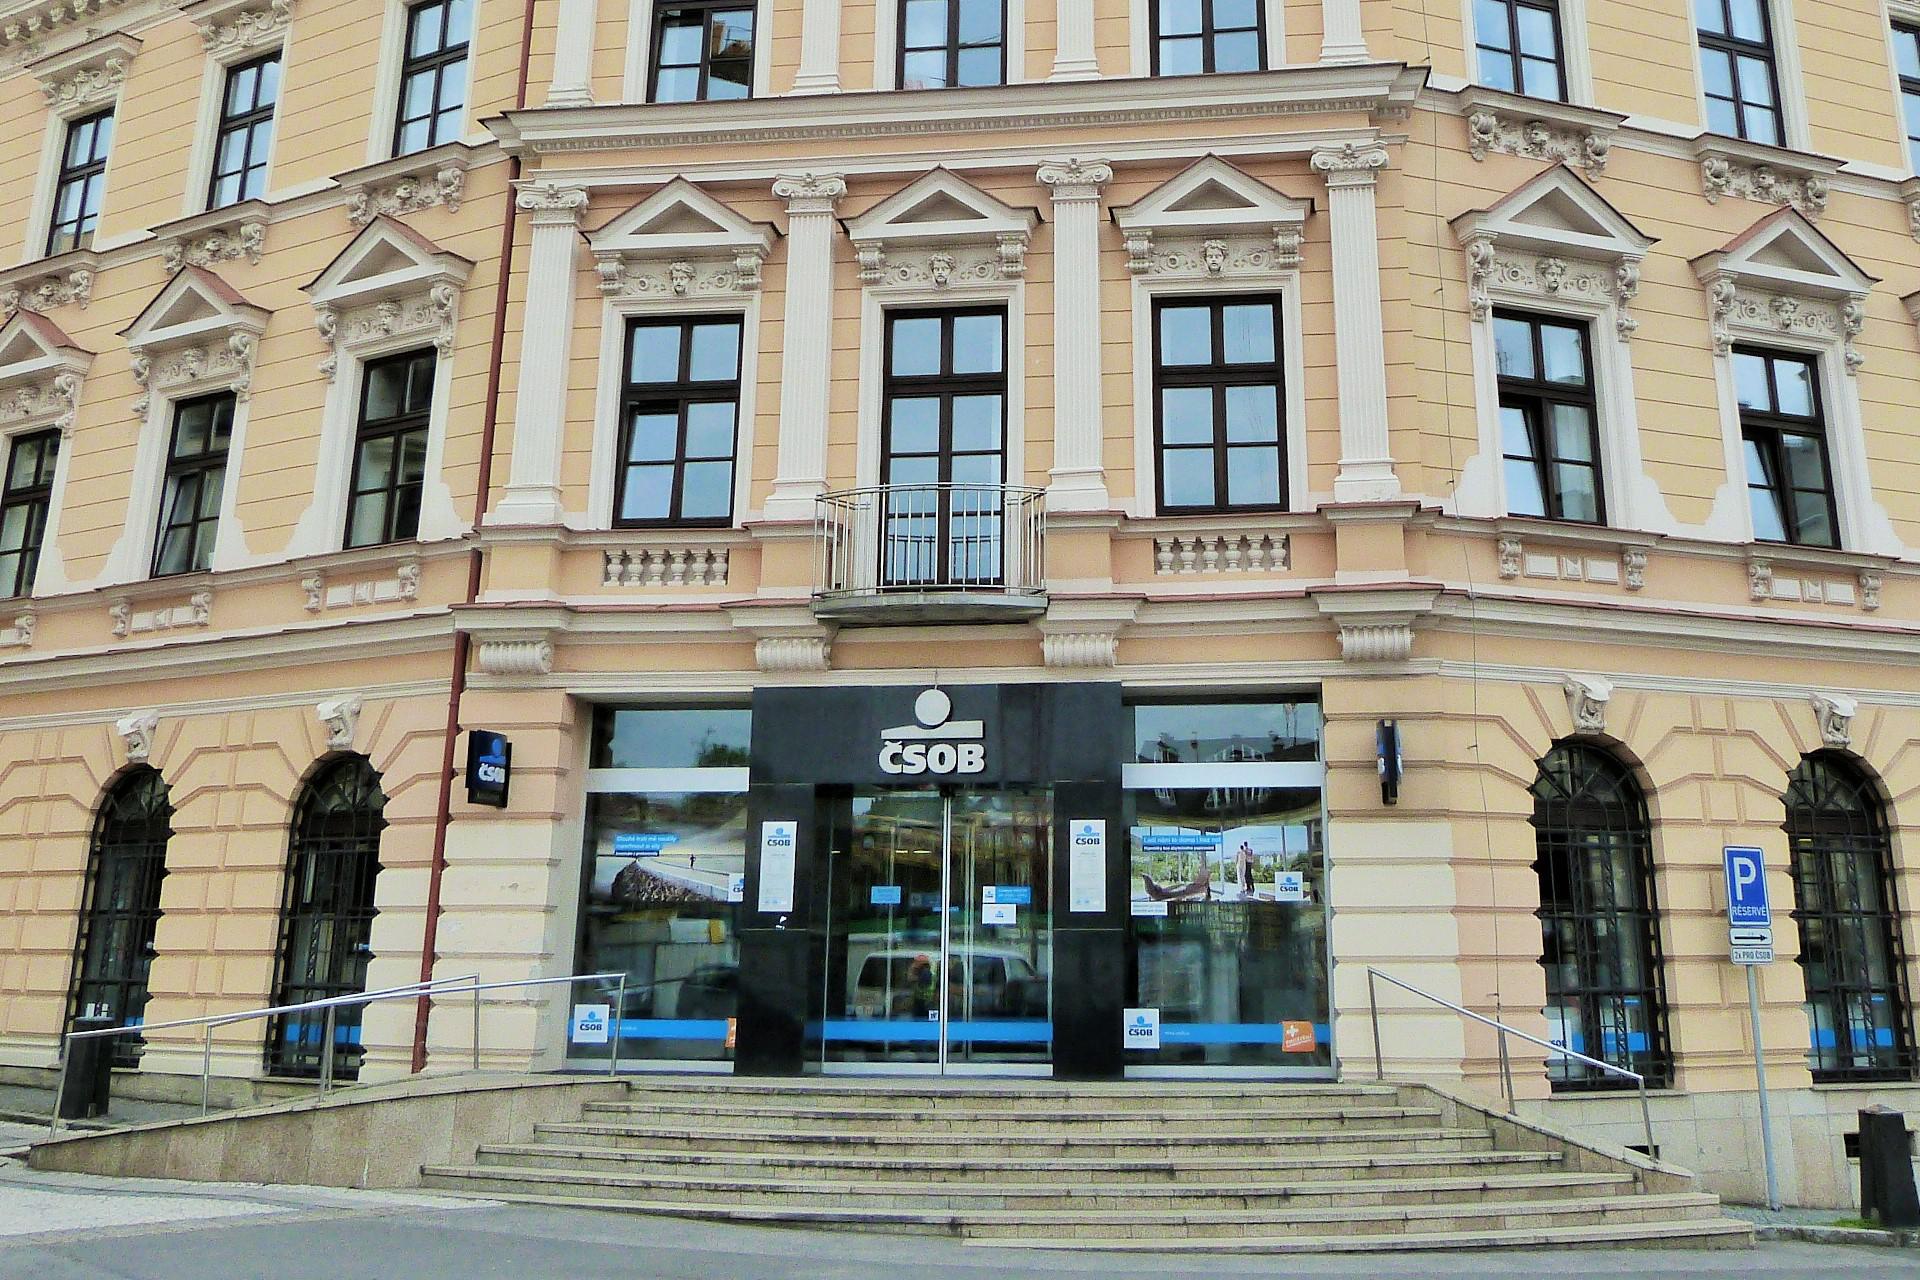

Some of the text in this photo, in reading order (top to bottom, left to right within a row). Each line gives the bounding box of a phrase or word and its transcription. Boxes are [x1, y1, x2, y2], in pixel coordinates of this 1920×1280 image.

[879, 740, 985, 775] ČSOB
[1733, 856, 1756, 901] P
[1731, 903, 1767, 917] RÉSERVÉ
[1742, 951, 1754, 960] PRO
